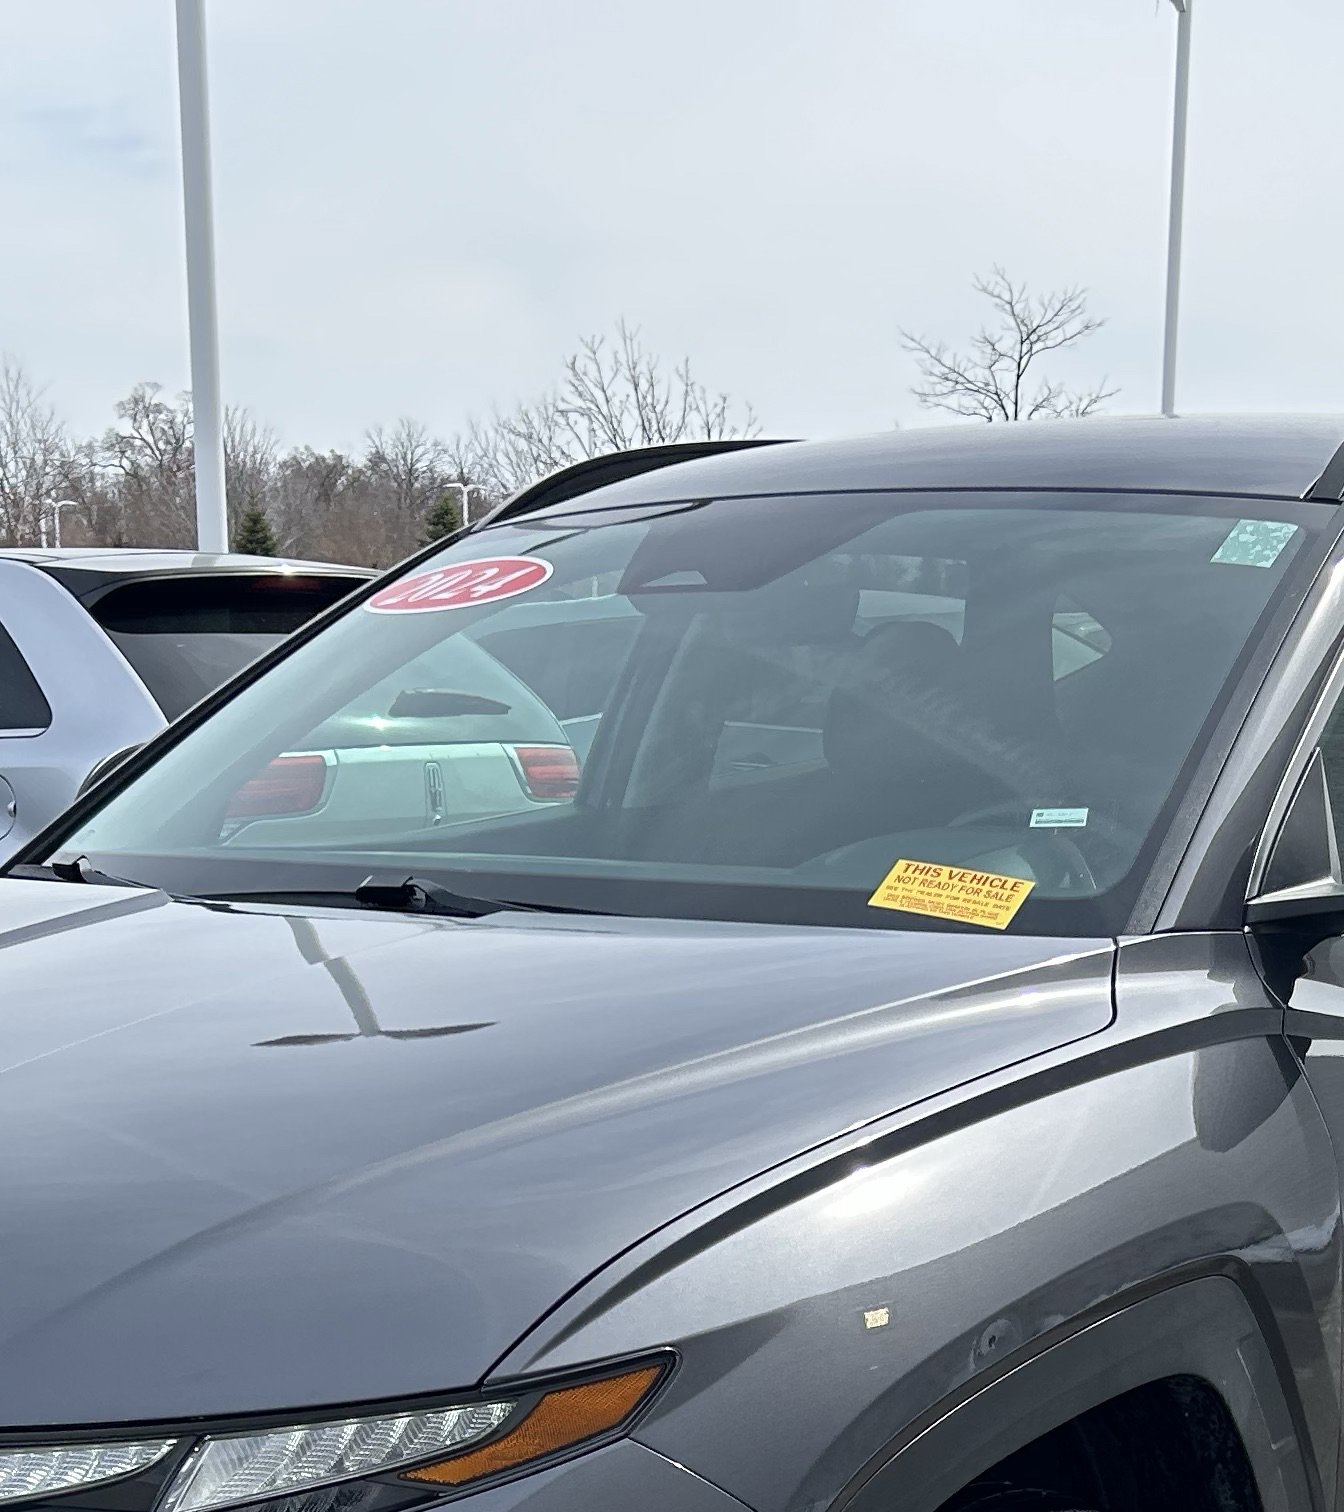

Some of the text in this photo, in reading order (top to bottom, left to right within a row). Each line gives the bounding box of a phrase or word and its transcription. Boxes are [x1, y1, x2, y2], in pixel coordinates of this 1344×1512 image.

[377, 565, 538, 607] 2024
[893, 874, 919, 886] NOT
[918, 878, 958, 892] READY
[958, 885, 983, 897] FOR
[983, 889, 1015, 903] SALE
[903, 862, 1025, 893] THIS VEHICLE
